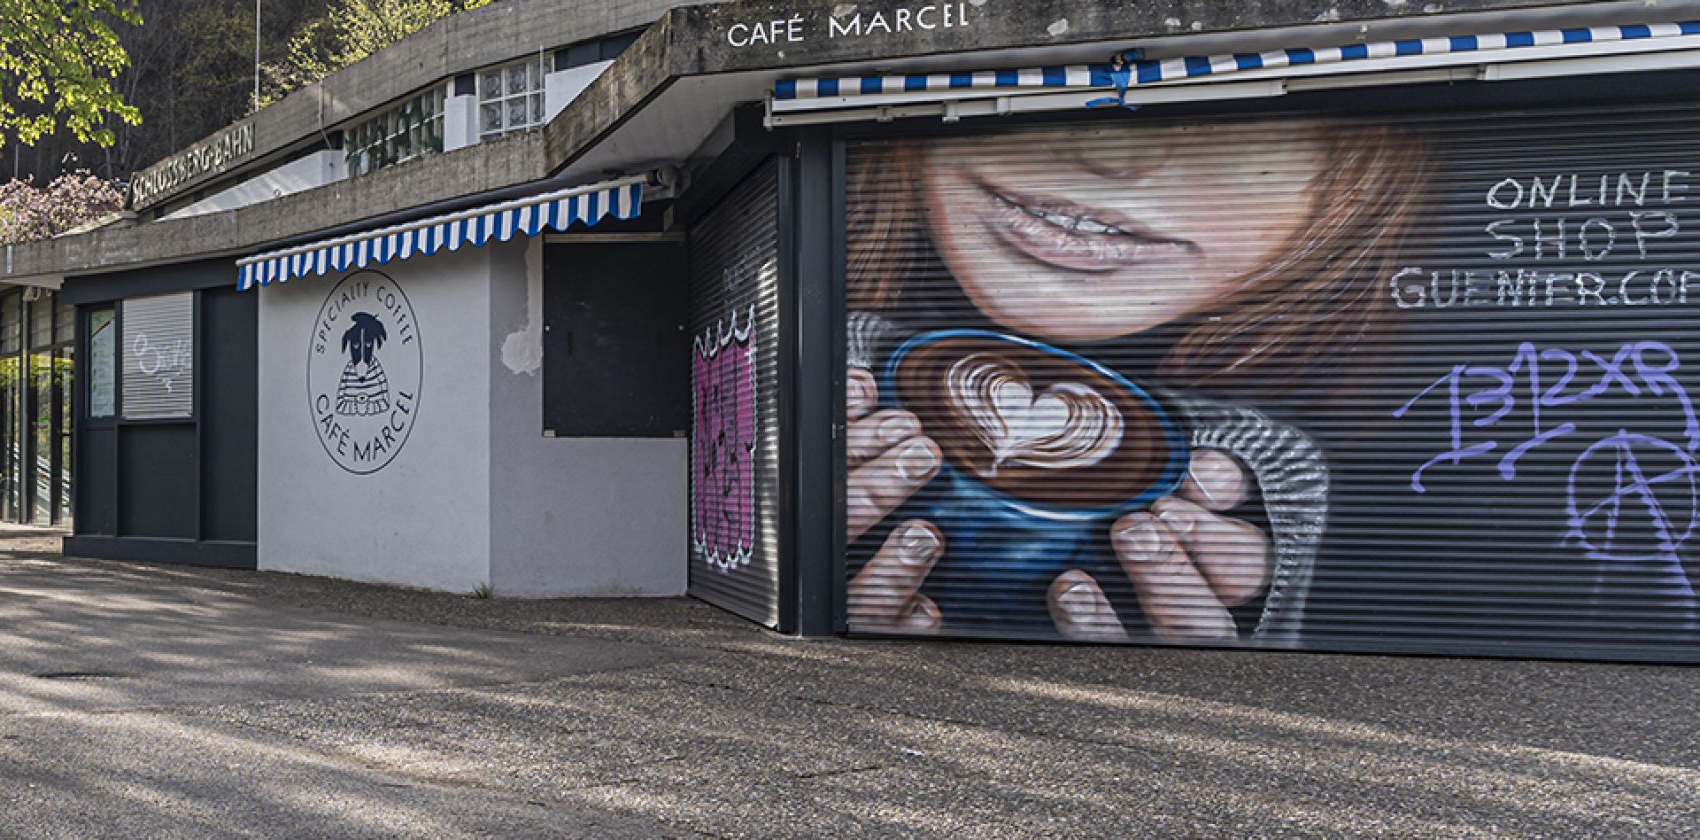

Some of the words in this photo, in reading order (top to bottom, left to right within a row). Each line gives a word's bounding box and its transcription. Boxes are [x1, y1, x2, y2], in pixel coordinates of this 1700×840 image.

[727, 13, 804, 47] CAFÉ
[828, 2, 970, 38] MARCEL
[1486, 169, 1690, 209] ONLINE
[1484, 210, 1679, 261] SHOP
[315, 281, 369, 354] SPECIALTY
[376, 284, 413, 345] COFFEE
[316, 393, 350, 456] CAFÉ
[353, 391, 413, 462] MARCEL
